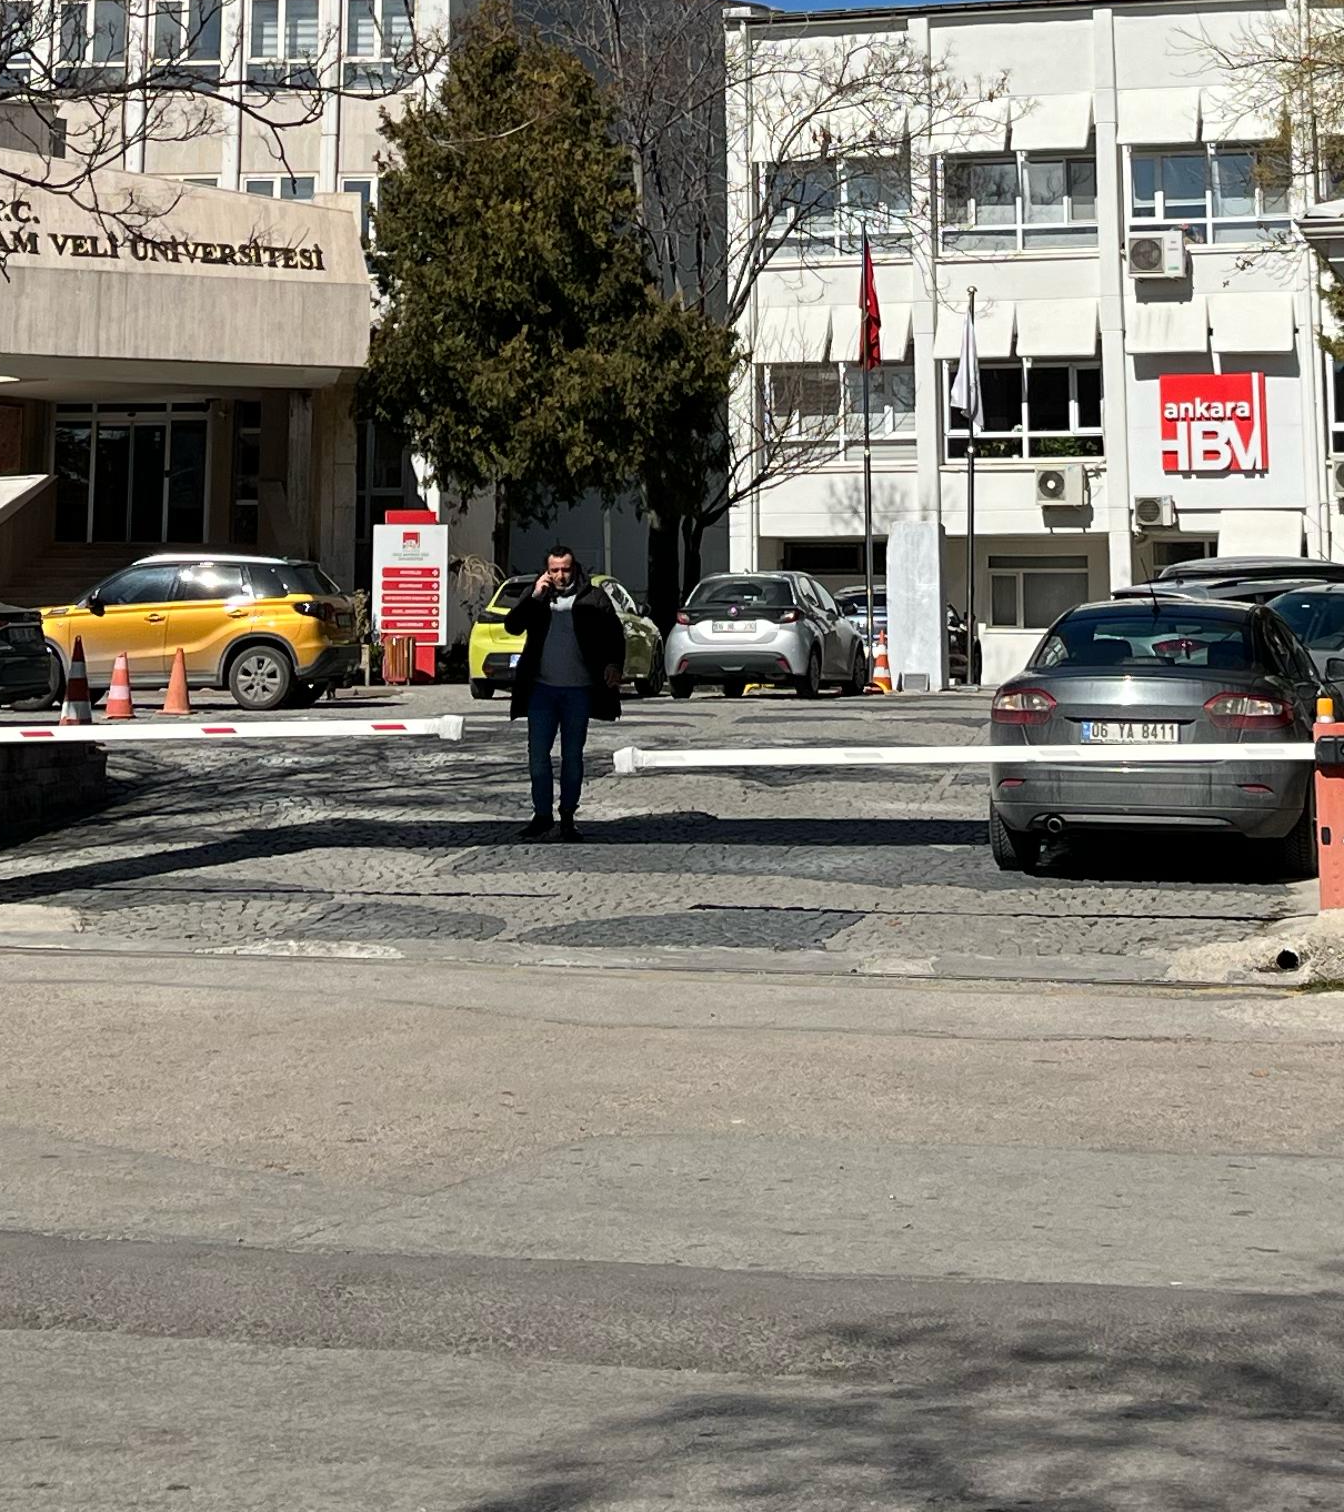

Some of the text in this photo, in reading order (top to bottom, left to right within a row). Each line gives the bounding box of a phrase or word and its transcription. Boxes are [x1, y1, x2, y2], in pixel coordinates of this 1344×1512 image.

[1164, 397, 1251, 420] ankara
[1091, 721, 1175, 740] 06 YA 8411
